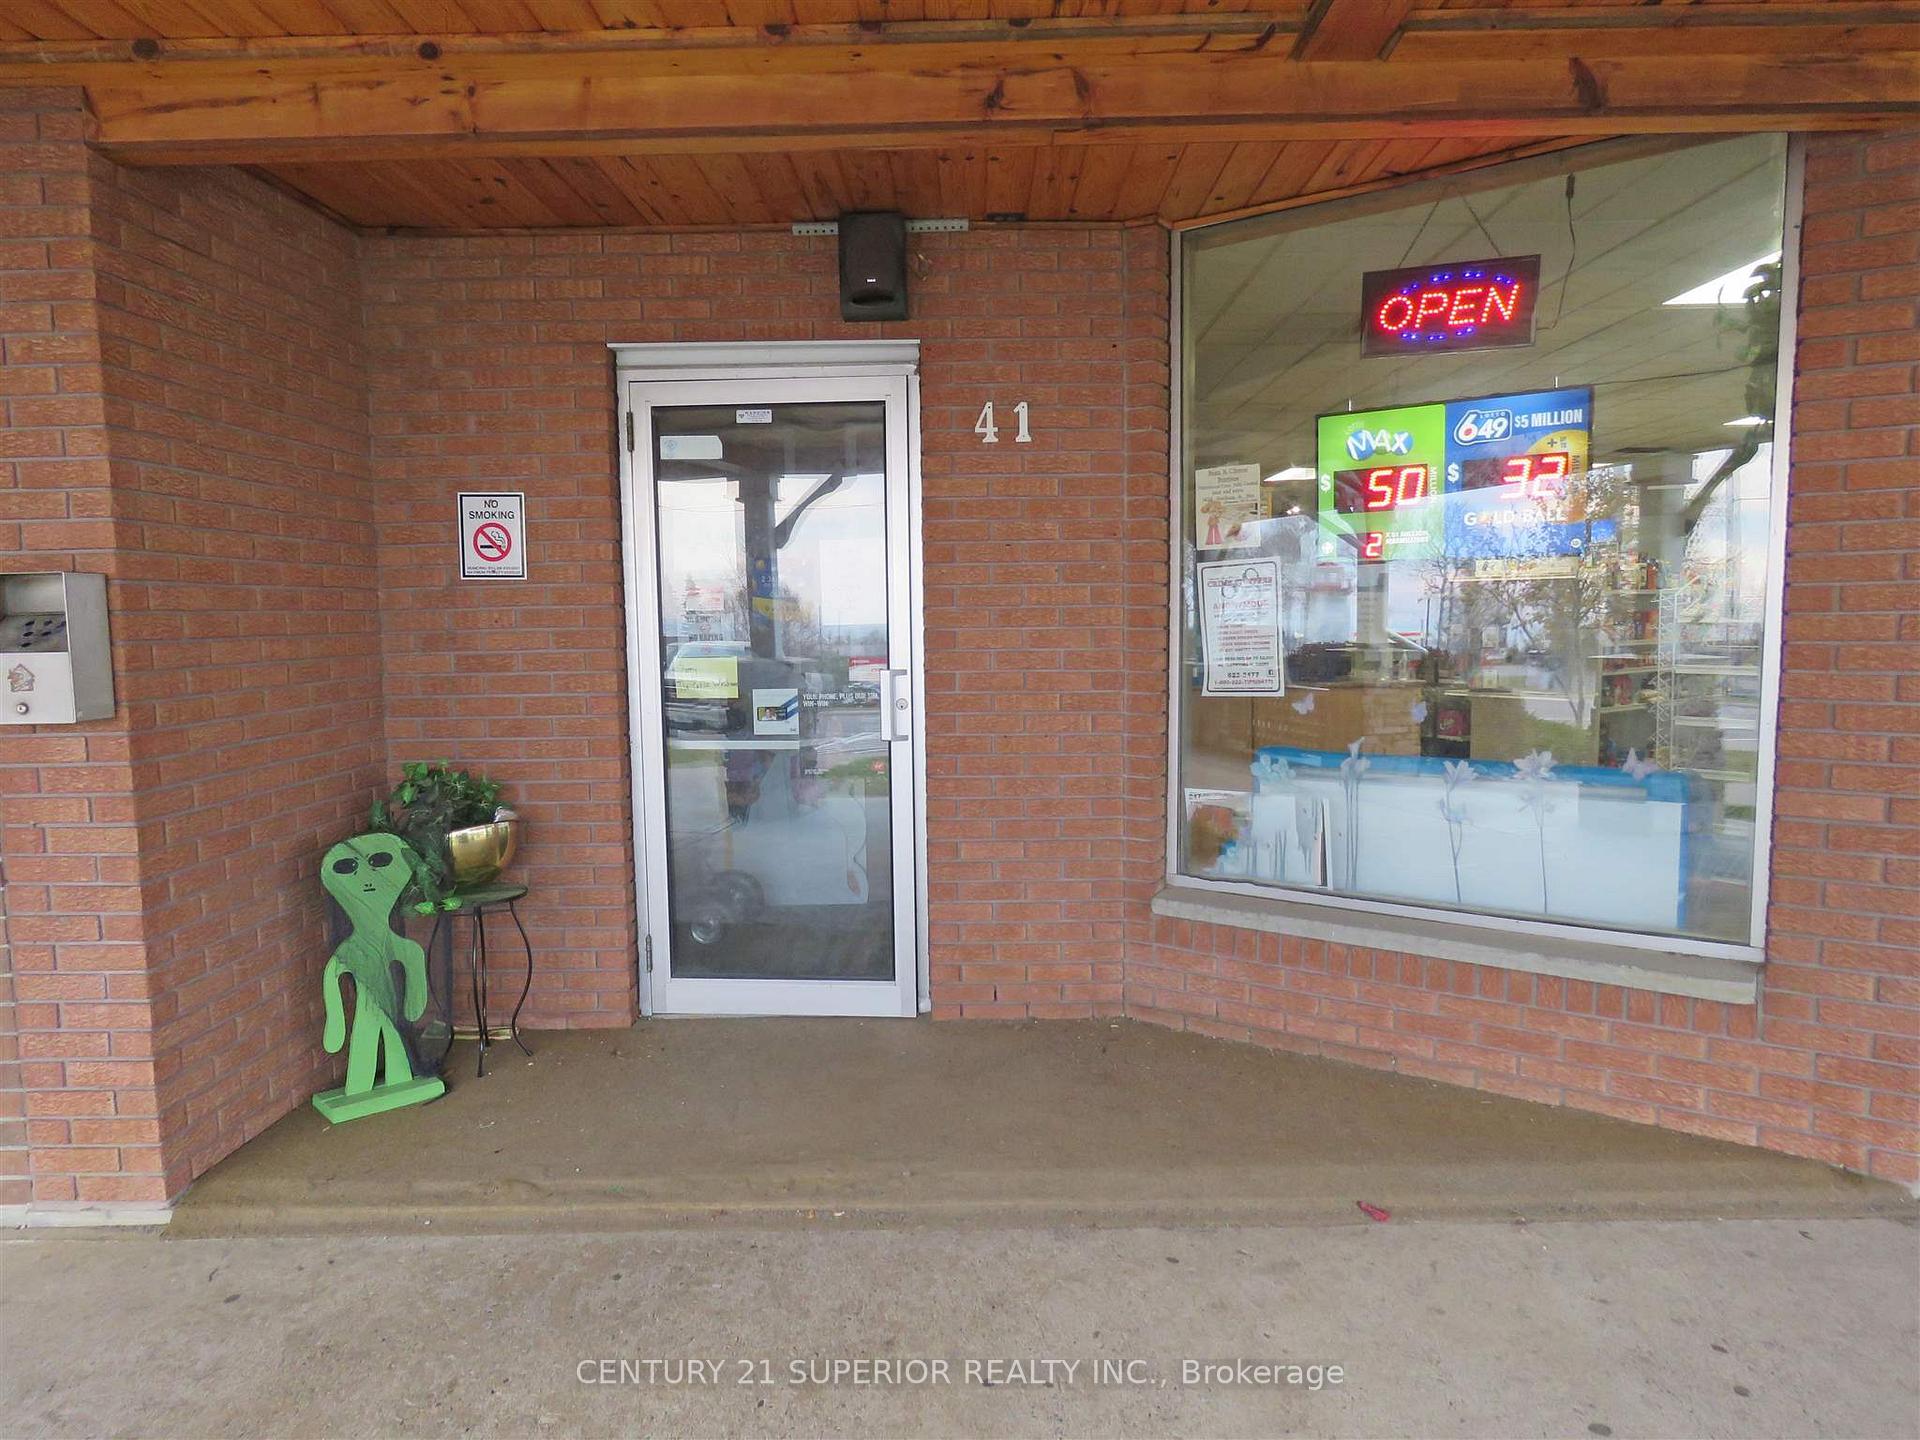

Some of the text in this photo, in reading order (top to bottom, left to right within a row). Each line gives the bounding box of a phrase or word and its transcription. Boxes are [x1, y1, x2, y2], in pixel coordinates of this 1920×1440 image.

[1380, 284, 1520, 331] OPEN
[975, 401, 1032, 442] 41
[1514, 409, 1583, 429] $5 MILLION
[1347, 429, 1409, 460] MAX
[1367, 467, 1427, 508] 50
[1447, 462, 1459, 483] $
[1501, 456, 1567, 499] 32
[469, 510, 515, 519] SMOKING
[484, 499, 499, 508] NO
[1366, 532, 1383, 557] 2
